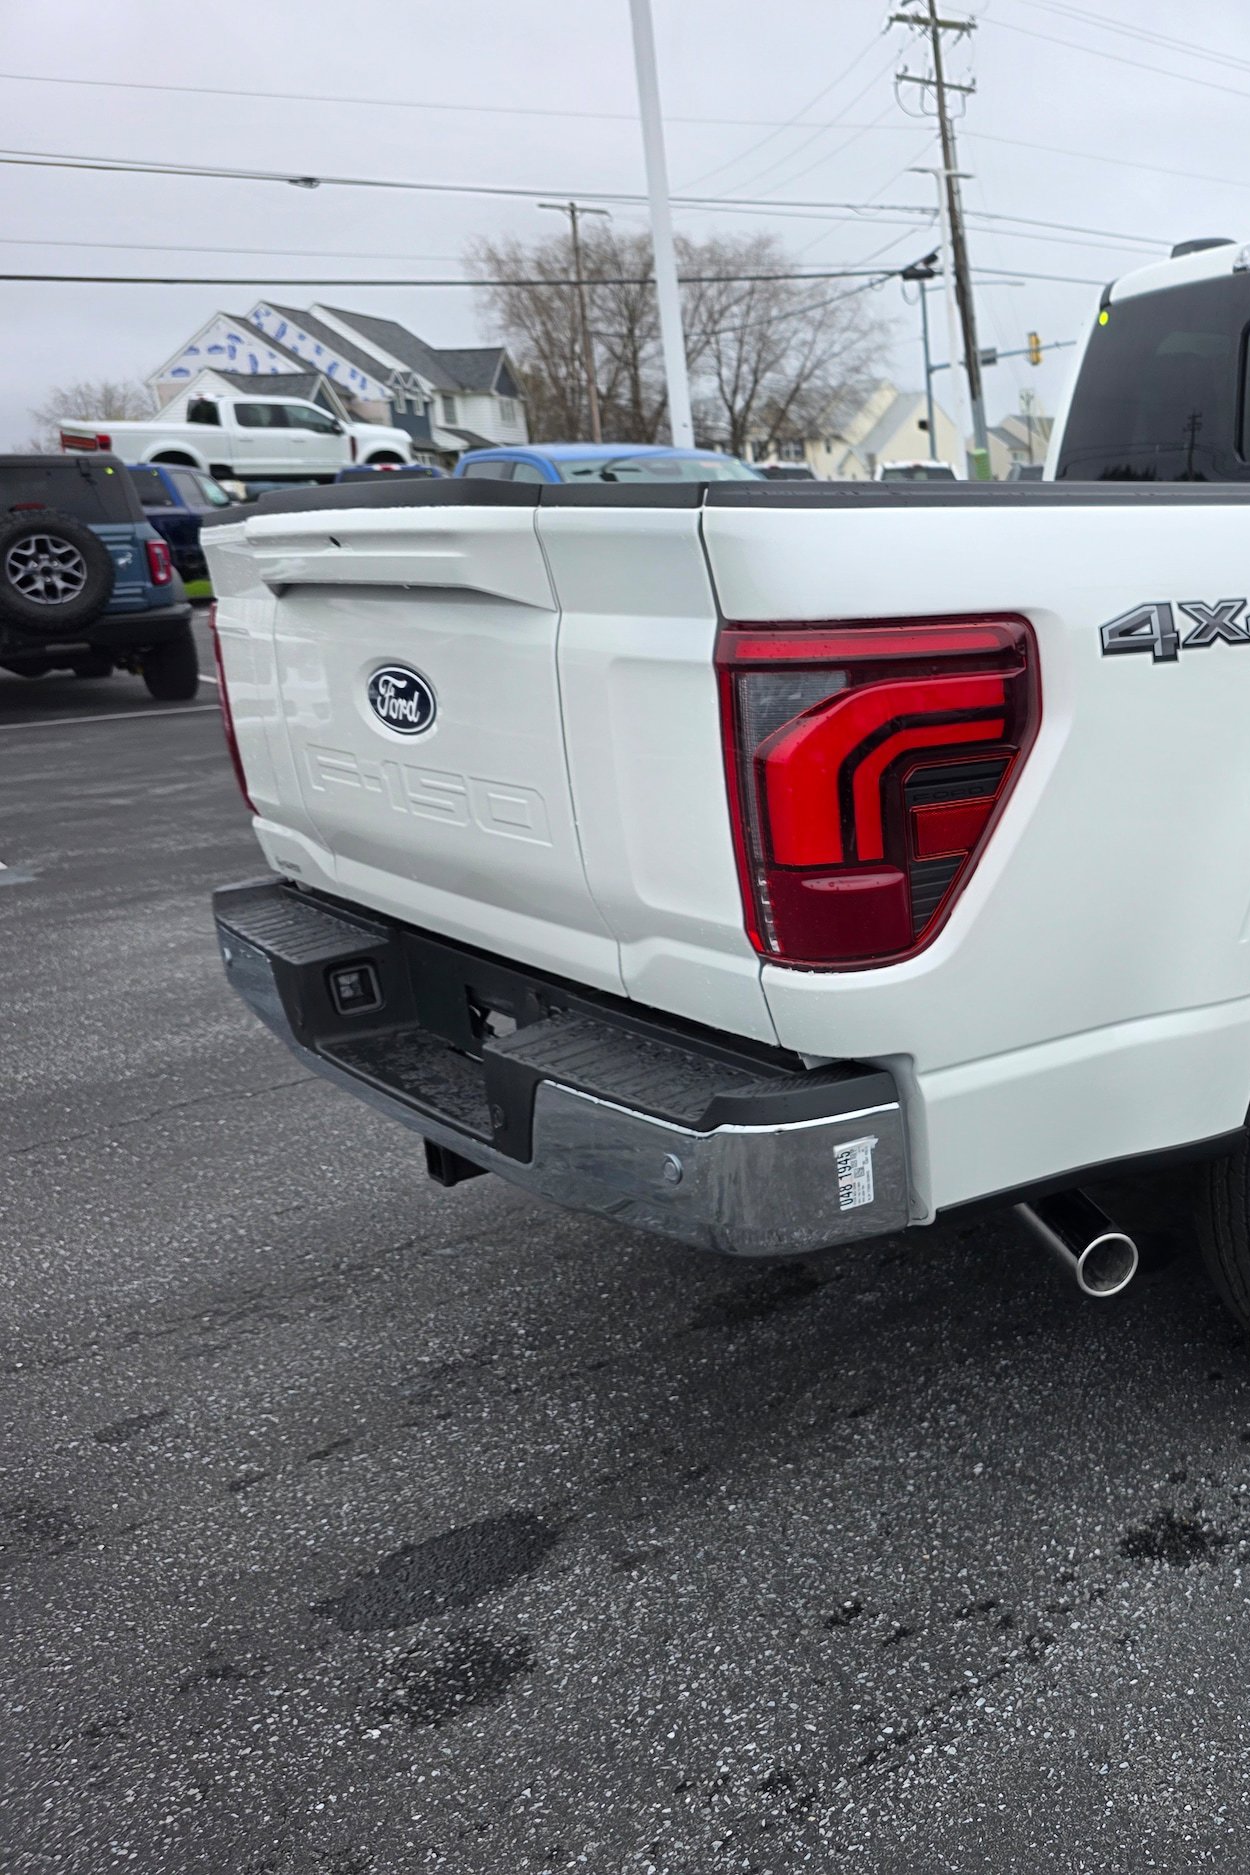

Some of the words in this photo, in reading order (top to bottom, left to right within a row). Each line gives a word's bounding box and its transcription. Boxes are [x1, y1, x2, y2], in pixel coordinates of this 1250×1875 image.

[376, 674, 422, 724] Ford
[304, 742, 553, 848] F-150
[912, 785, 985, 802] FORD
[837, 1151, 853, 1181] 1945
